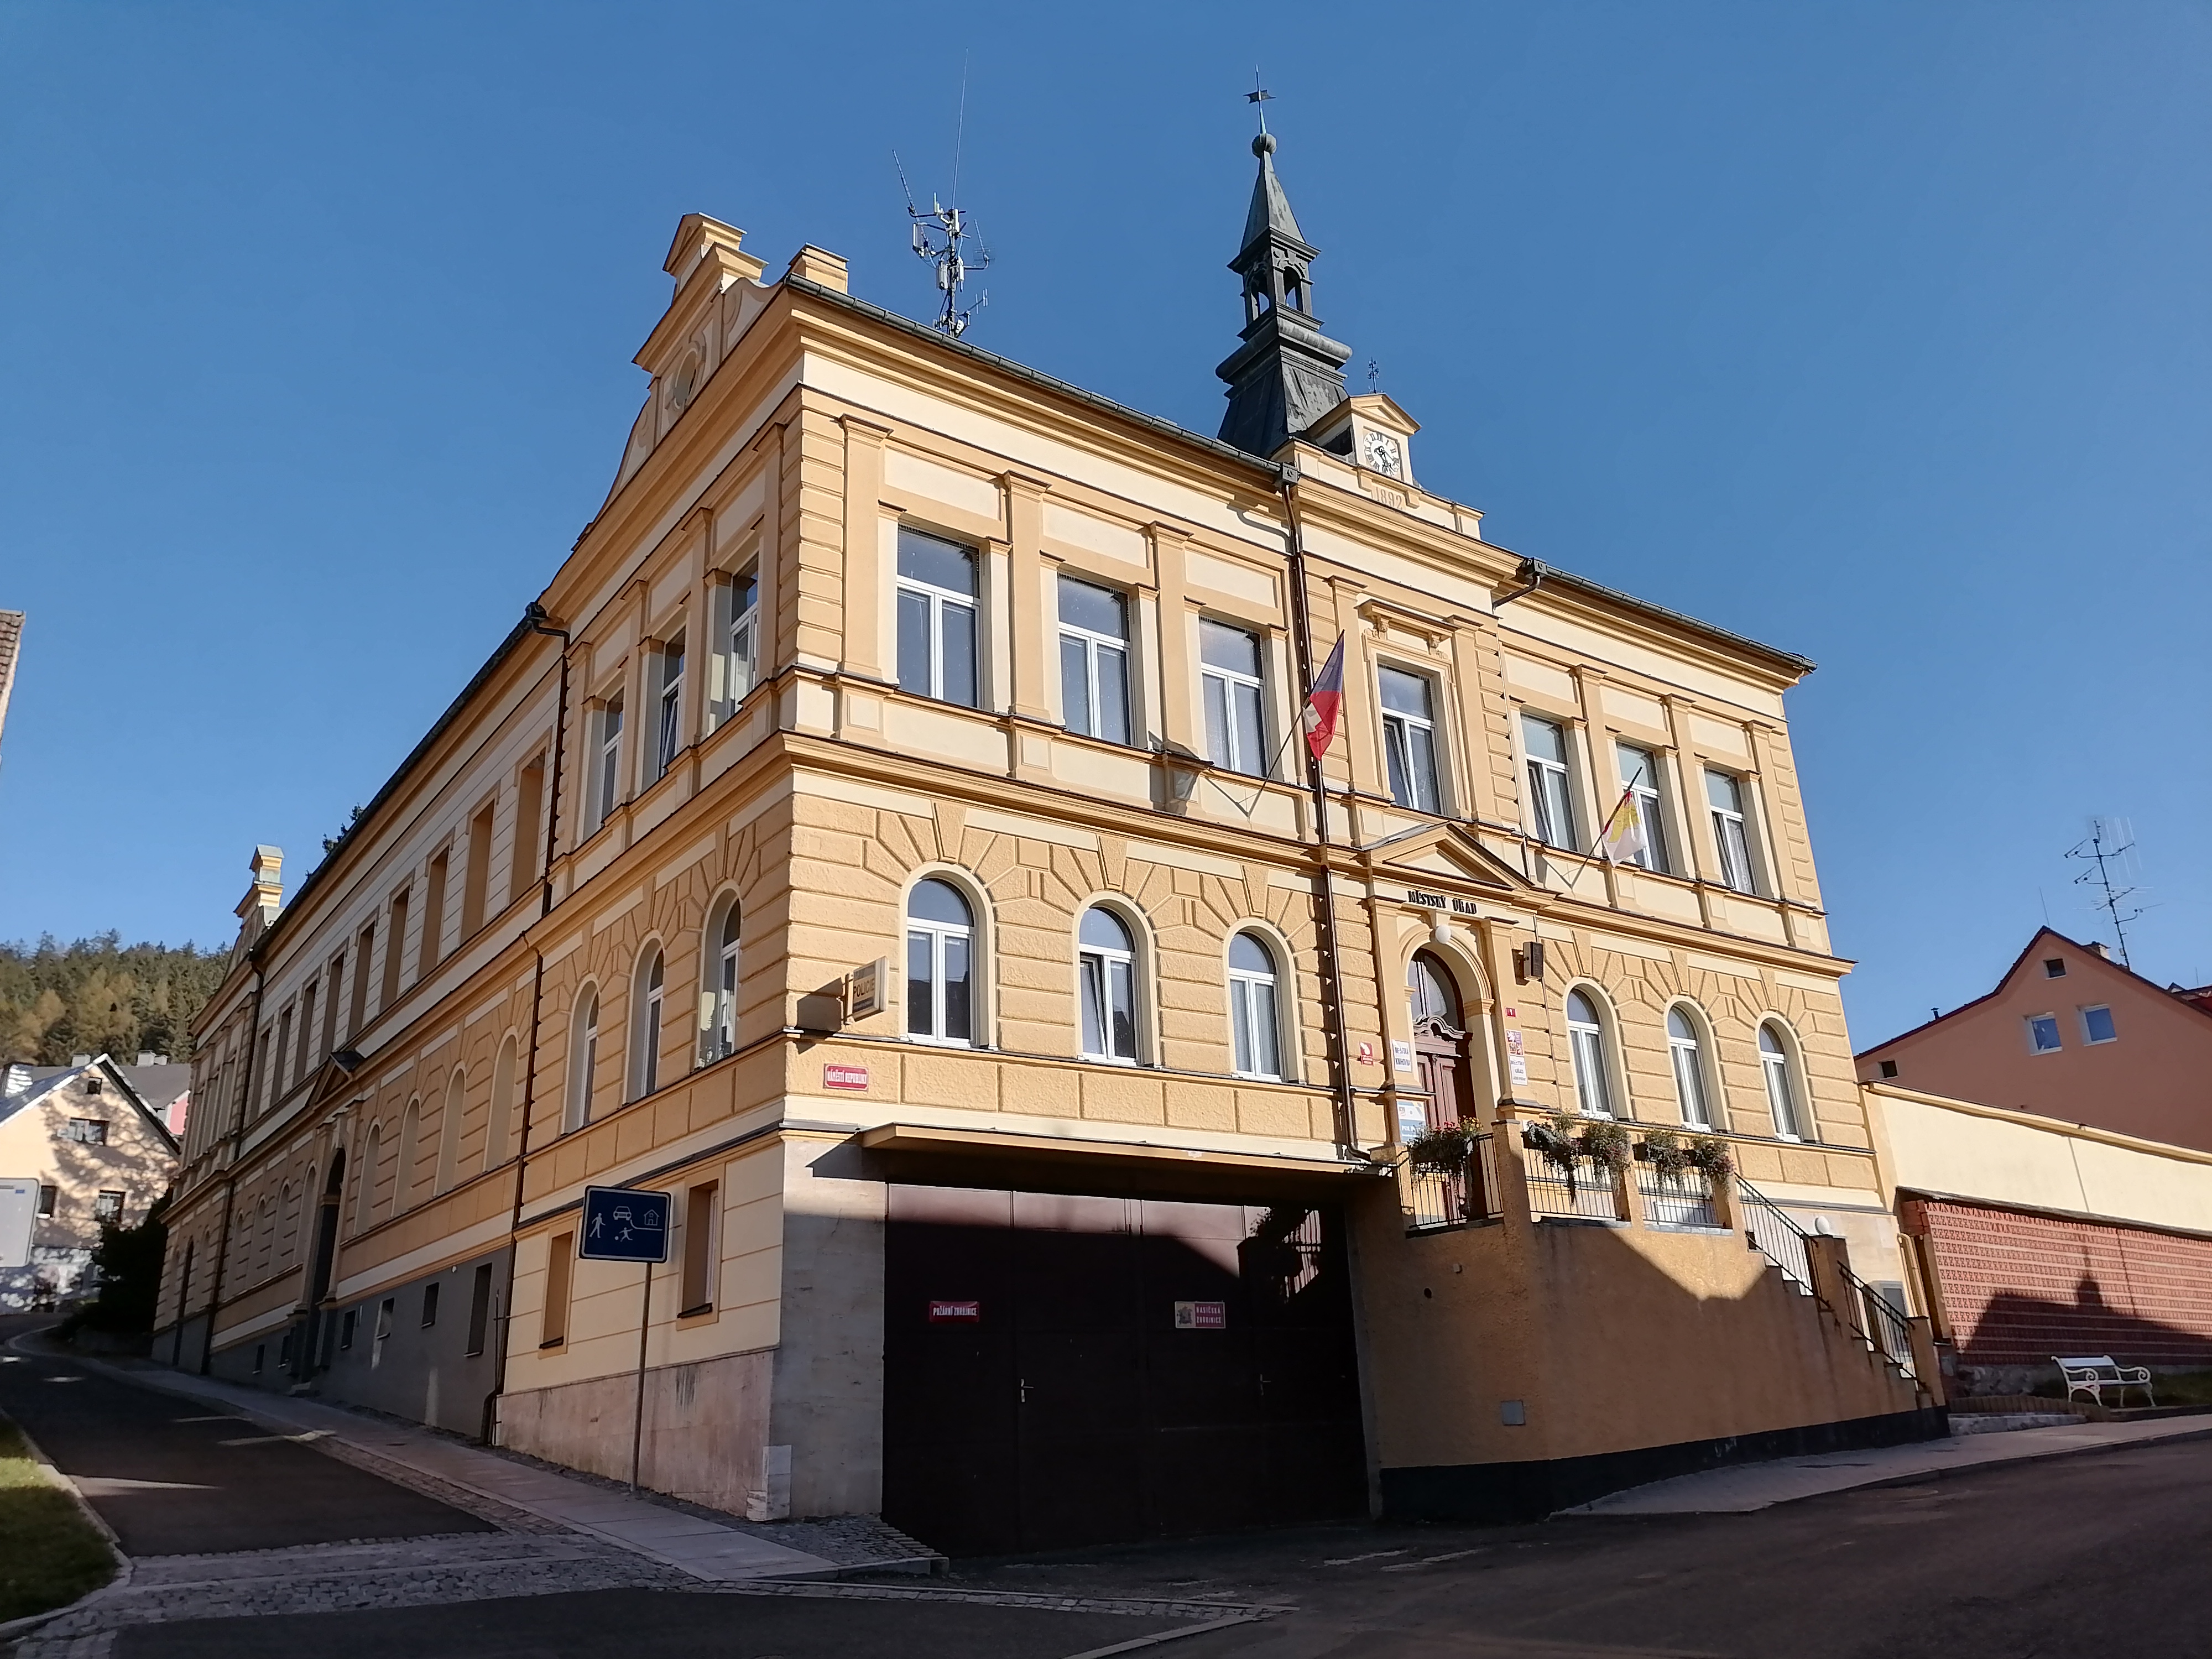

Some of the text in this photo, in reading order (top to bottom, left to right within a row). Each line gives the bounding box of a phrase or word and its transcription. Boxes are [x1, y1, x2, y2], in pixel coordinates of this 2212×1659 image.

[1375, 486, 1403, 510] 1892
[853, 978, 875, 998] POLICIE
[933, 1305, 953, 1316] POŽÁRNÍ
